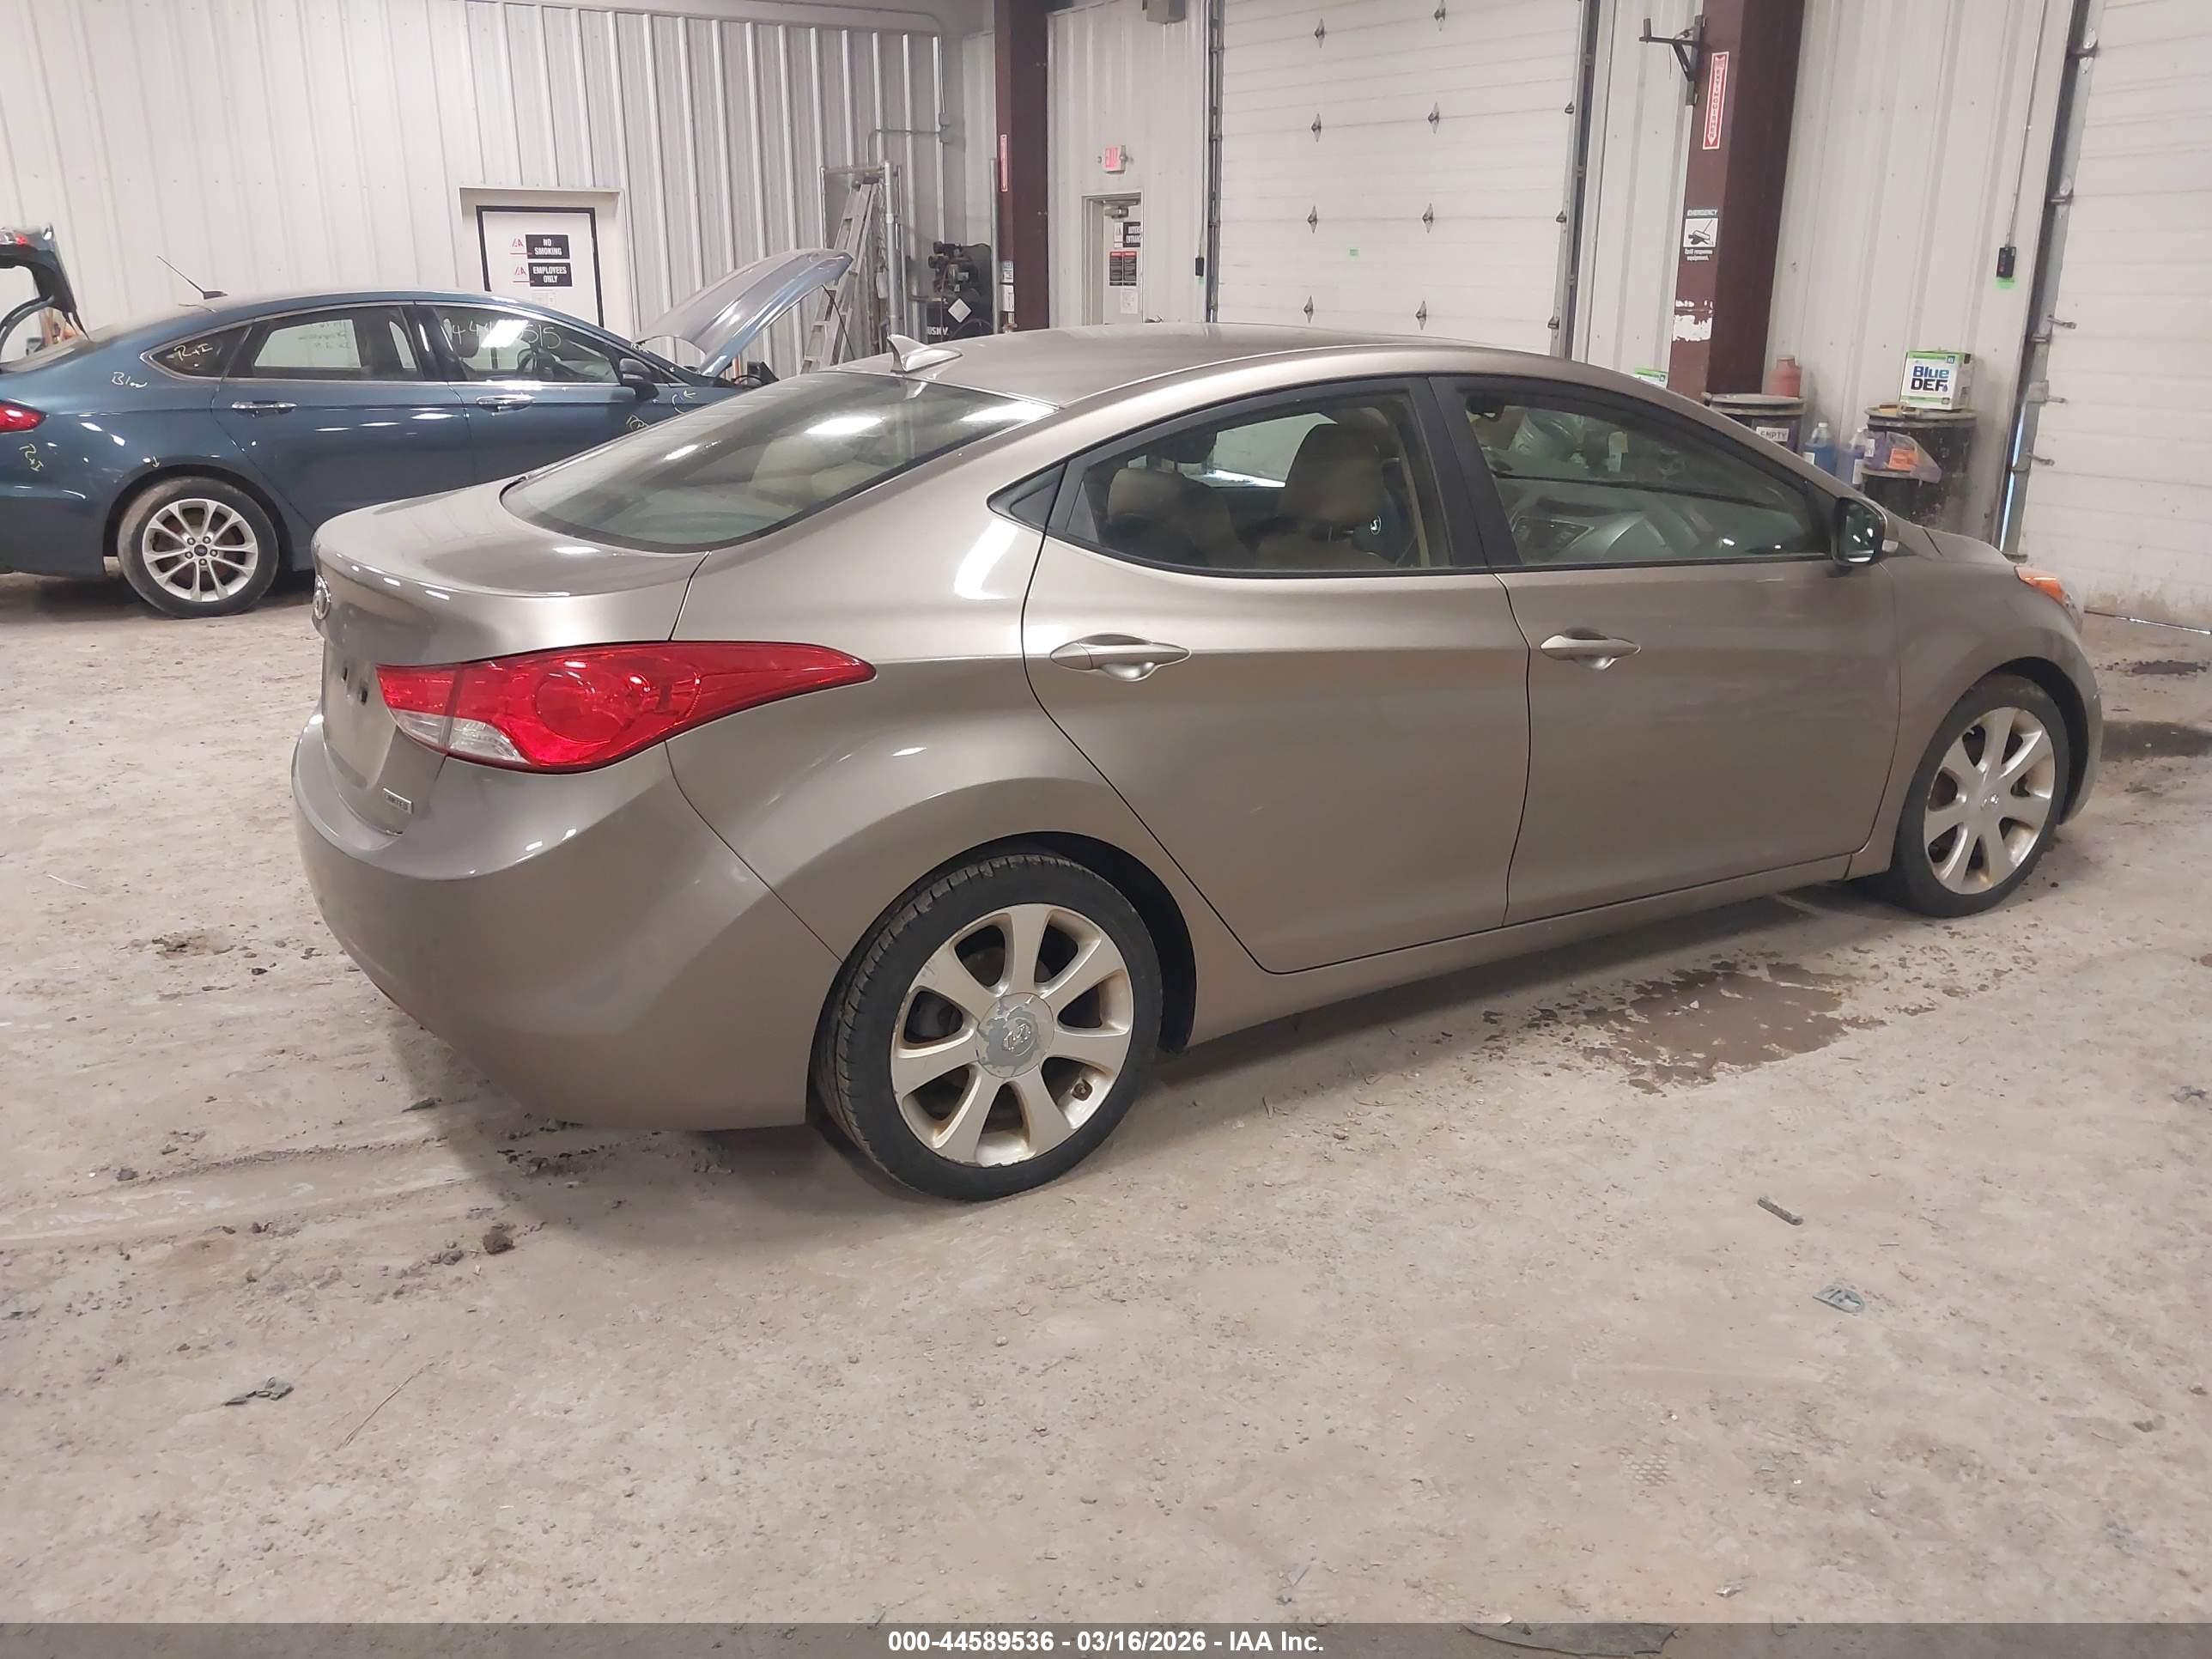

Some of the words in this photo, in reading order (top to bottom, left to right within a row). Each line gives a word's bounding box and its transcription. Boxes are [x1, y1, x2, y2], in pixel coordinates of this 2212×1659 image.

[534, 247, 562, 256] SMOKING
[532, 266, 567, 275] EMPLOYEES
[543, 275, 558, 283] ONLY
[1912, 366, 1950, 379] Blue
[1911, 378, 1948, 392] DEF
[1760, 430, 1787, 441] EMPTY
